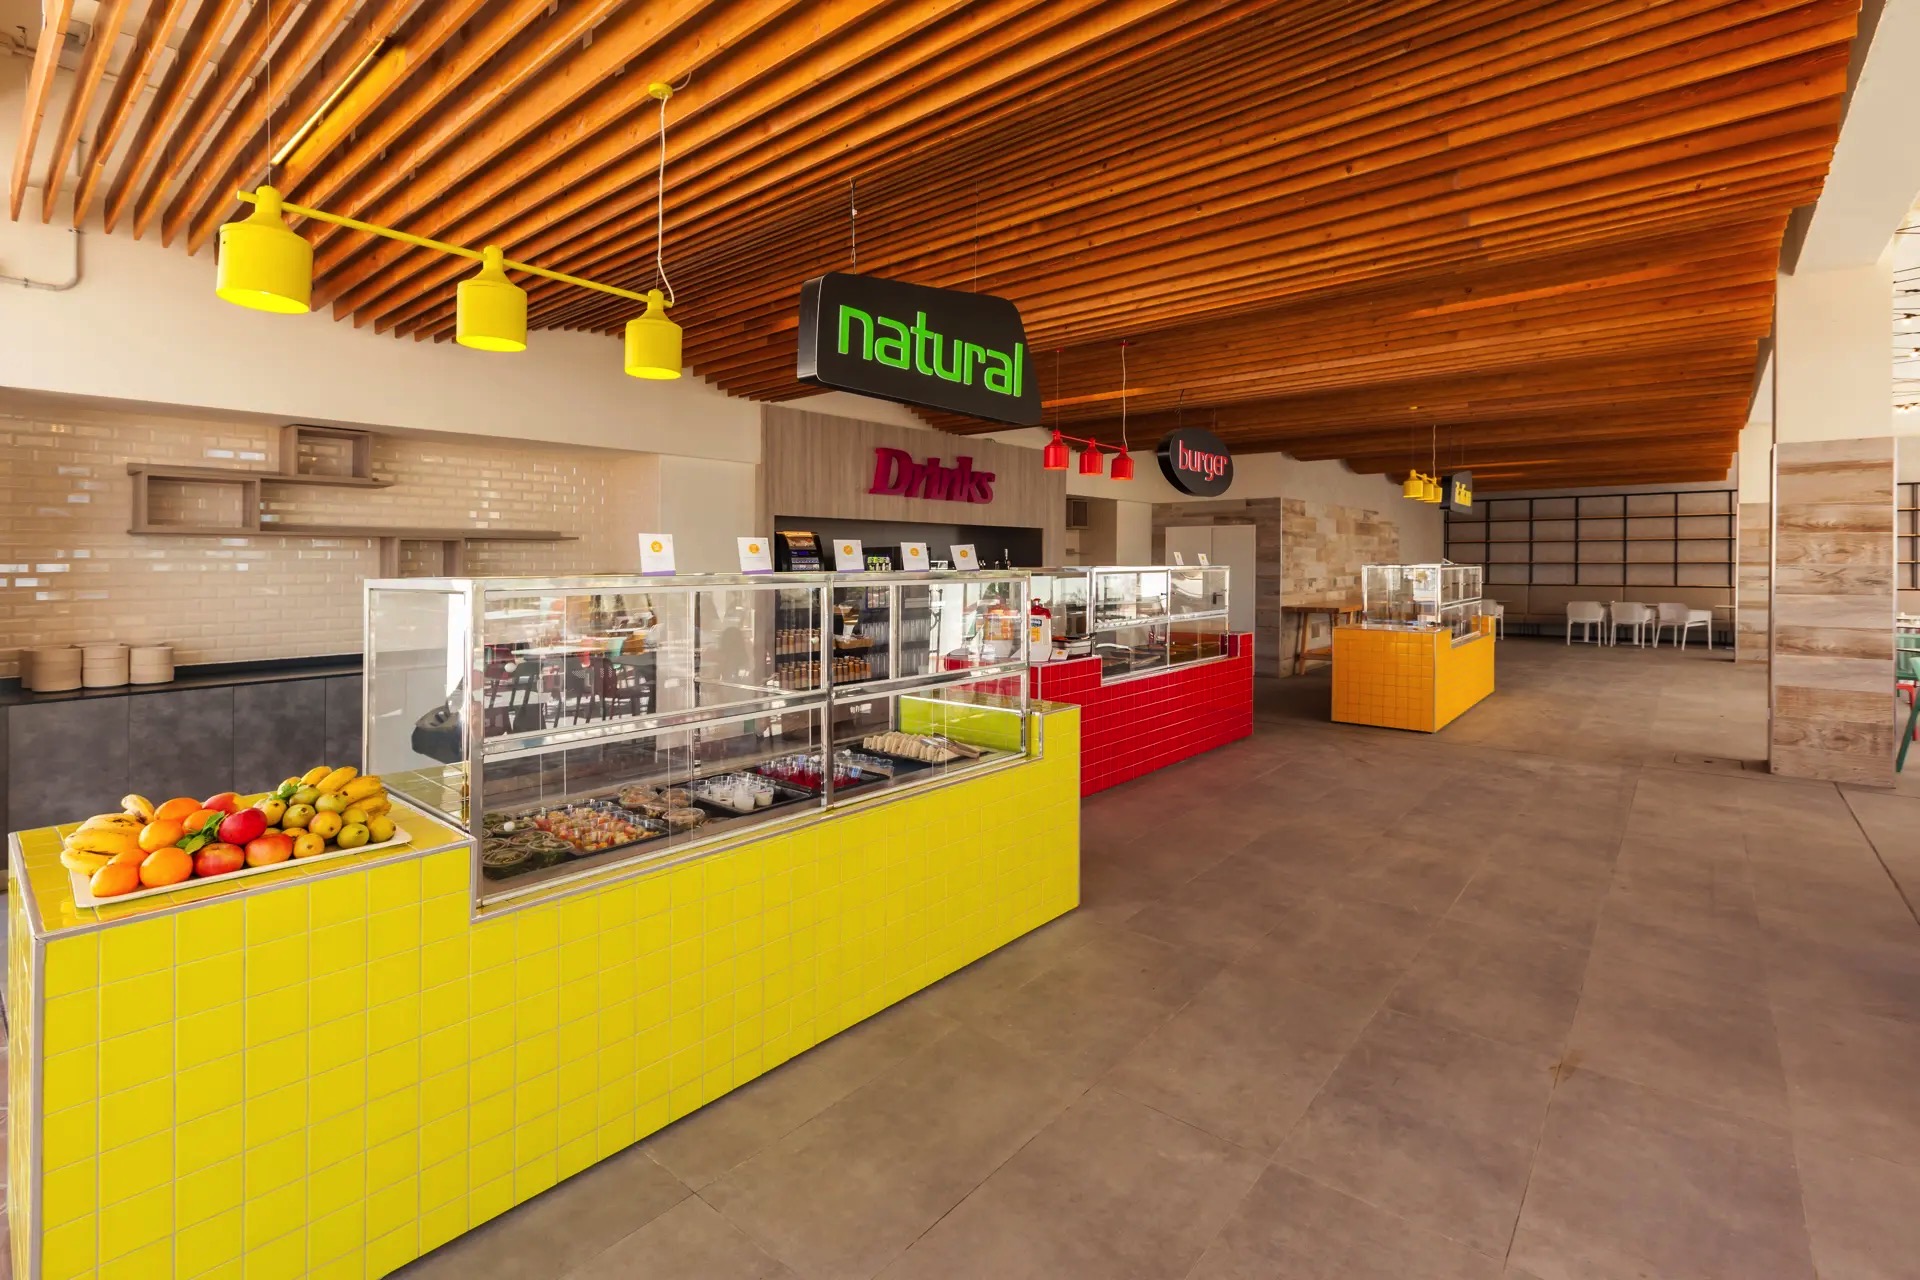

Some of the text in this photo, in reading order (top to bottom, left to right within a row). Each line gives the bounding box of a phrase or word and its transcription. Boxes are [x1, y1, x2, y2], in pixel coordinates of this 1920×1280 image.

[838, 304, 1024, 398] natural
[868, 447, 996, 504] Drinks
[1177, 439, 1228, 482] burger
